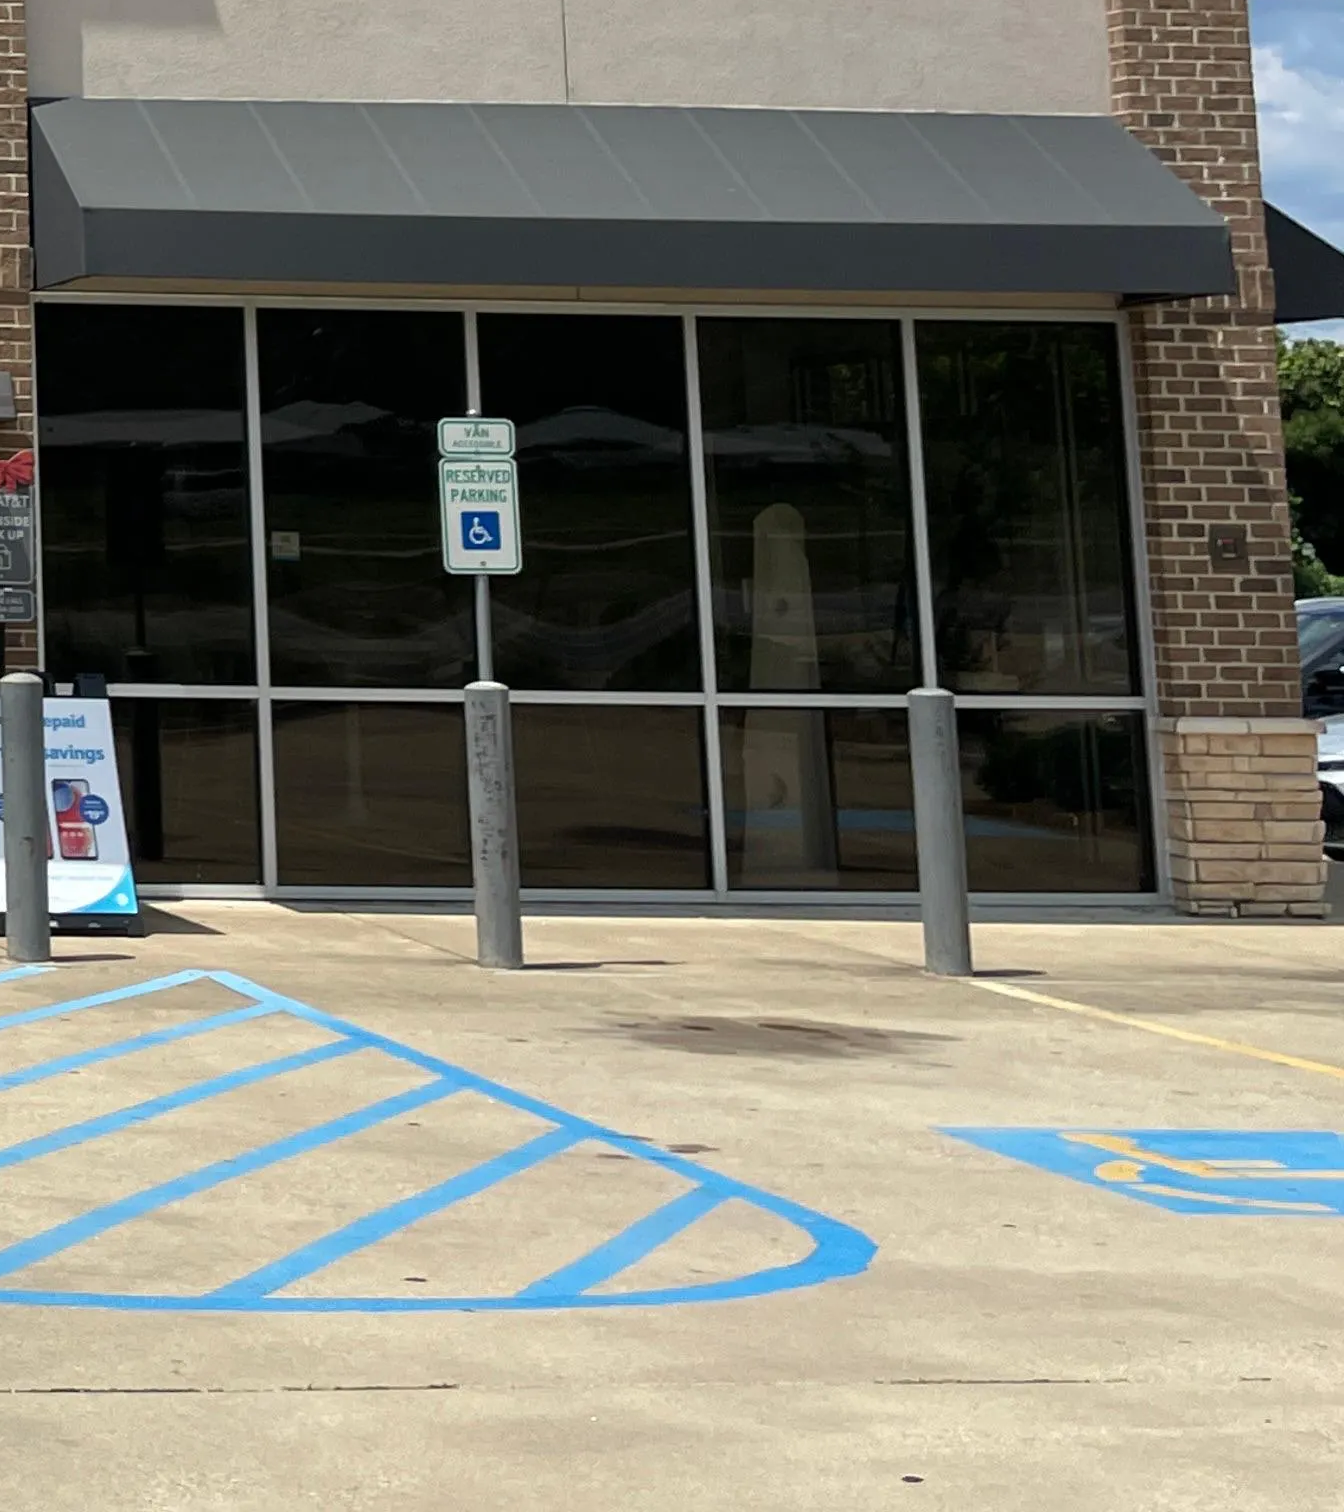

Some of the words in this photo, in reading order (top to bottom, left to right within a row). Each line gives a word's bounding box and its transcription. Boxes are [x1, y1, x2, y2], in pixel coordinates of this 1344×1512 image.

[463, 427, 490, 438] VAN
[445, 469, 511, 484] RESERVED
[450, 488, 508, 503] PARKING
[7, 529, 24, 541] UP
[43, 715, 86, 731] epaid
